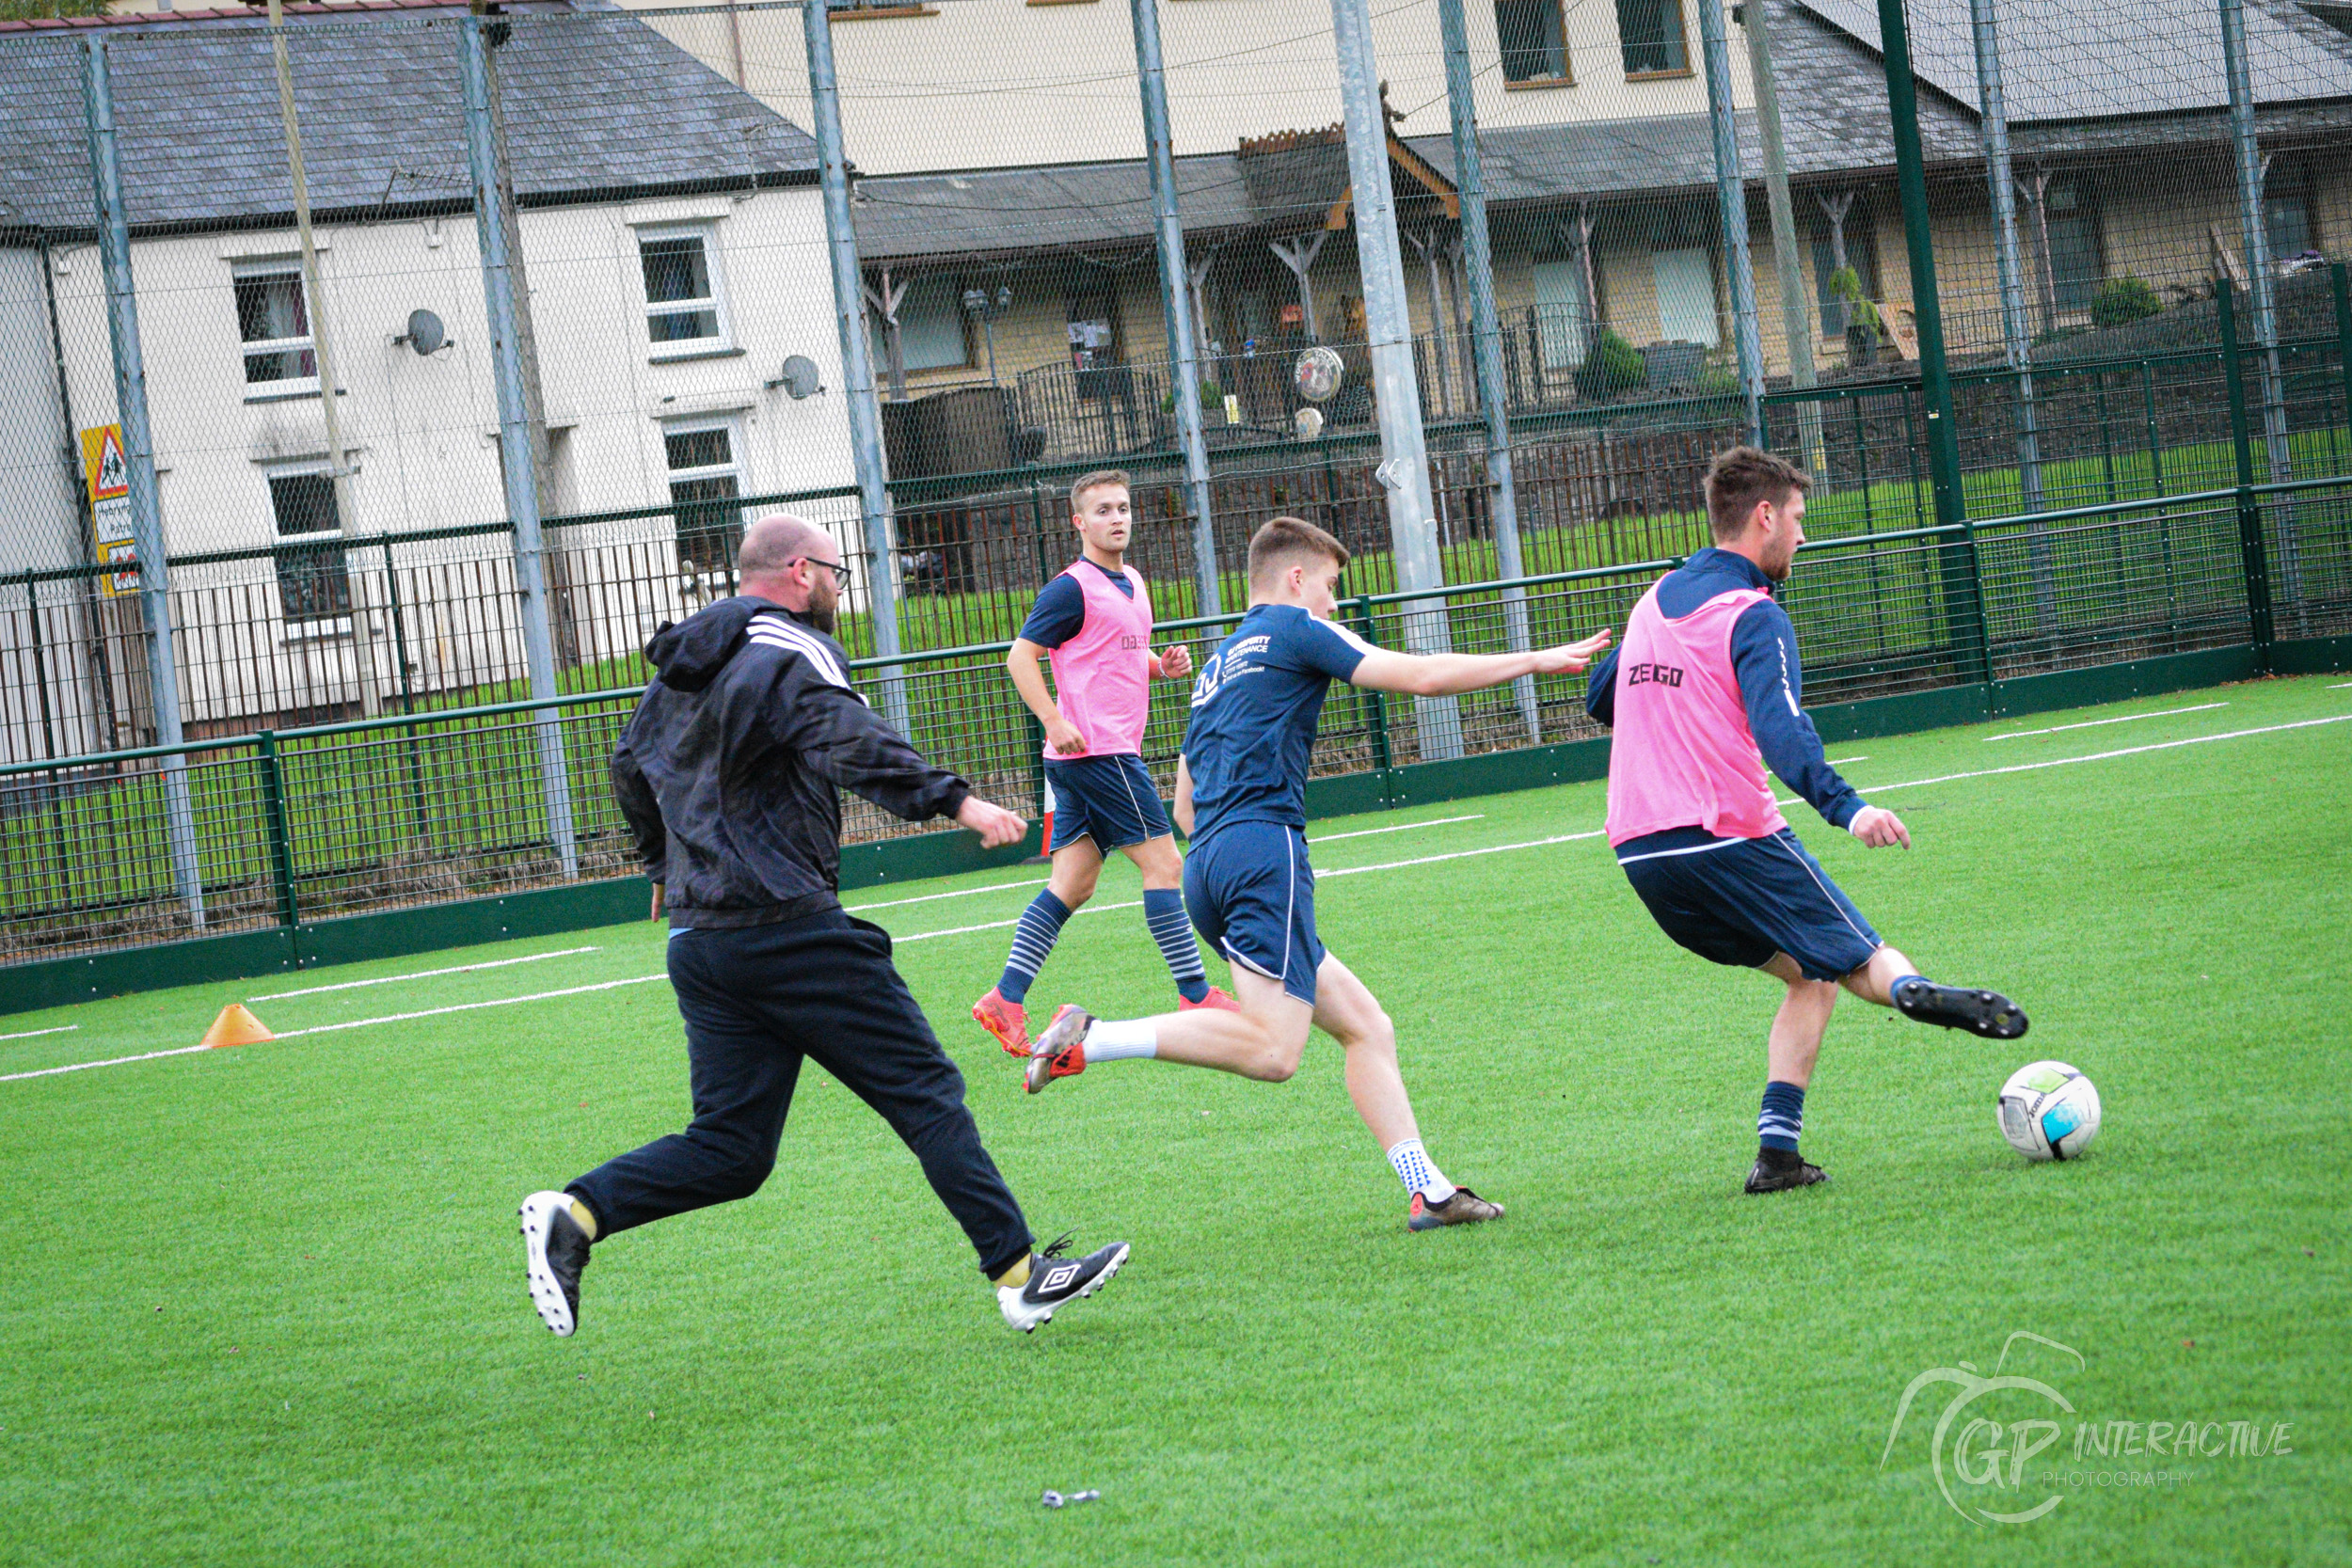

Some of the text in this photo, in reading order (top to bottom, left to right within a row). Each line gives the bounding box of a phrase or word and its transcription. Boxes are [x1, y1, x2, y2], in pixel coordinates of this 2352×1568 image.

[110, 523, 132, 534] Patro
[1234, 635, 1271, 650] PROPERTY
[1629, 663, 1684, 688] ZEGO
